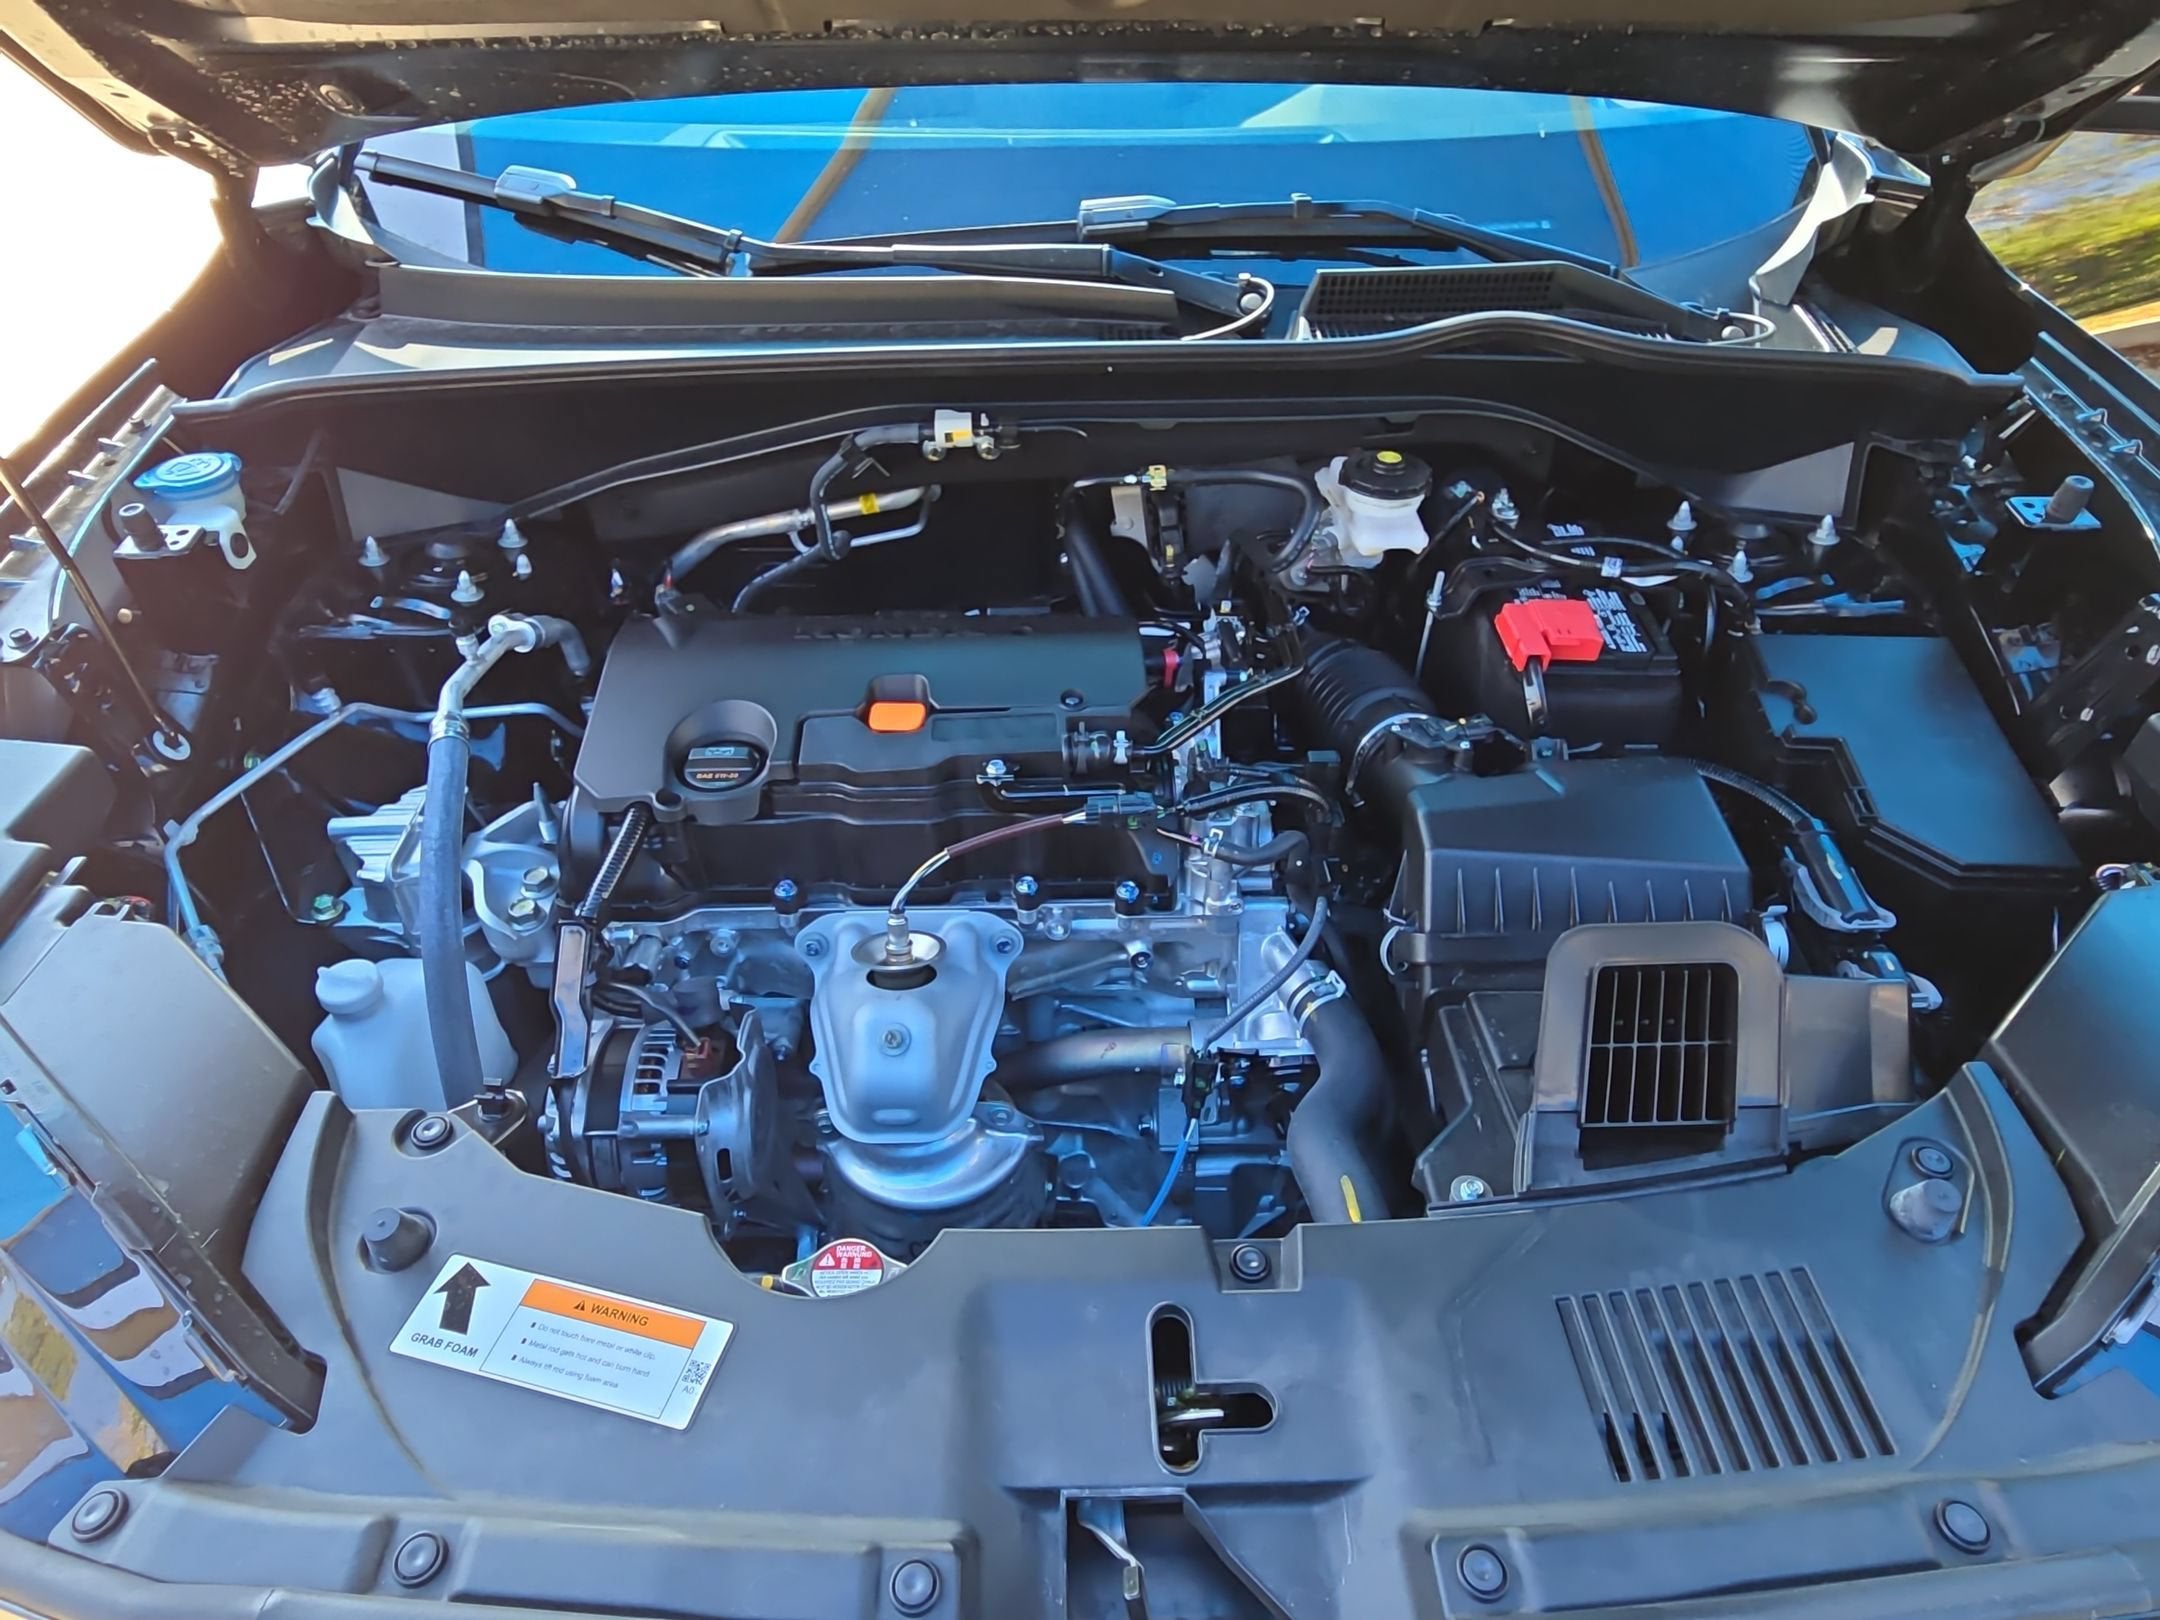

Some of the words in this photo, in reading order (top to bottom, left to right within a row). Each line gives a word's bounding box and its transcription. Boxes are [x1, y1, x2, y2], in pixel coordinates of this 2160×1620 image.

[591, 1303, 649, 1326] WARNING
[411, 1332, 444, 1348] GRAB
[444, 1341, 479, 1358] FOAM
[550, 1327, 561, 1335] not
[561, 1330, 580, 1340] touch
[596, 1338, 615, 1349] metal
[625, 1346, 643, 1356] white
[518, 1356, 543, 1369] Always
[553, 1365, 565, 1374] rod
[565, 1369, 584, 1381] using
[602, 1378, 619, 1388] area
[528, 1339, 547, 1350] Metal
[548, 1344, 560, 1354] rod
[560, 1348, 575, 1358] gets
[575, 1351, 587, 1361] hot
[587, 1355, 601, 1365] and
[602, 1360, 615, 1368] can
[615, 1362, 631, 1373] burn
[632, 1367, 651, 1377] hand
